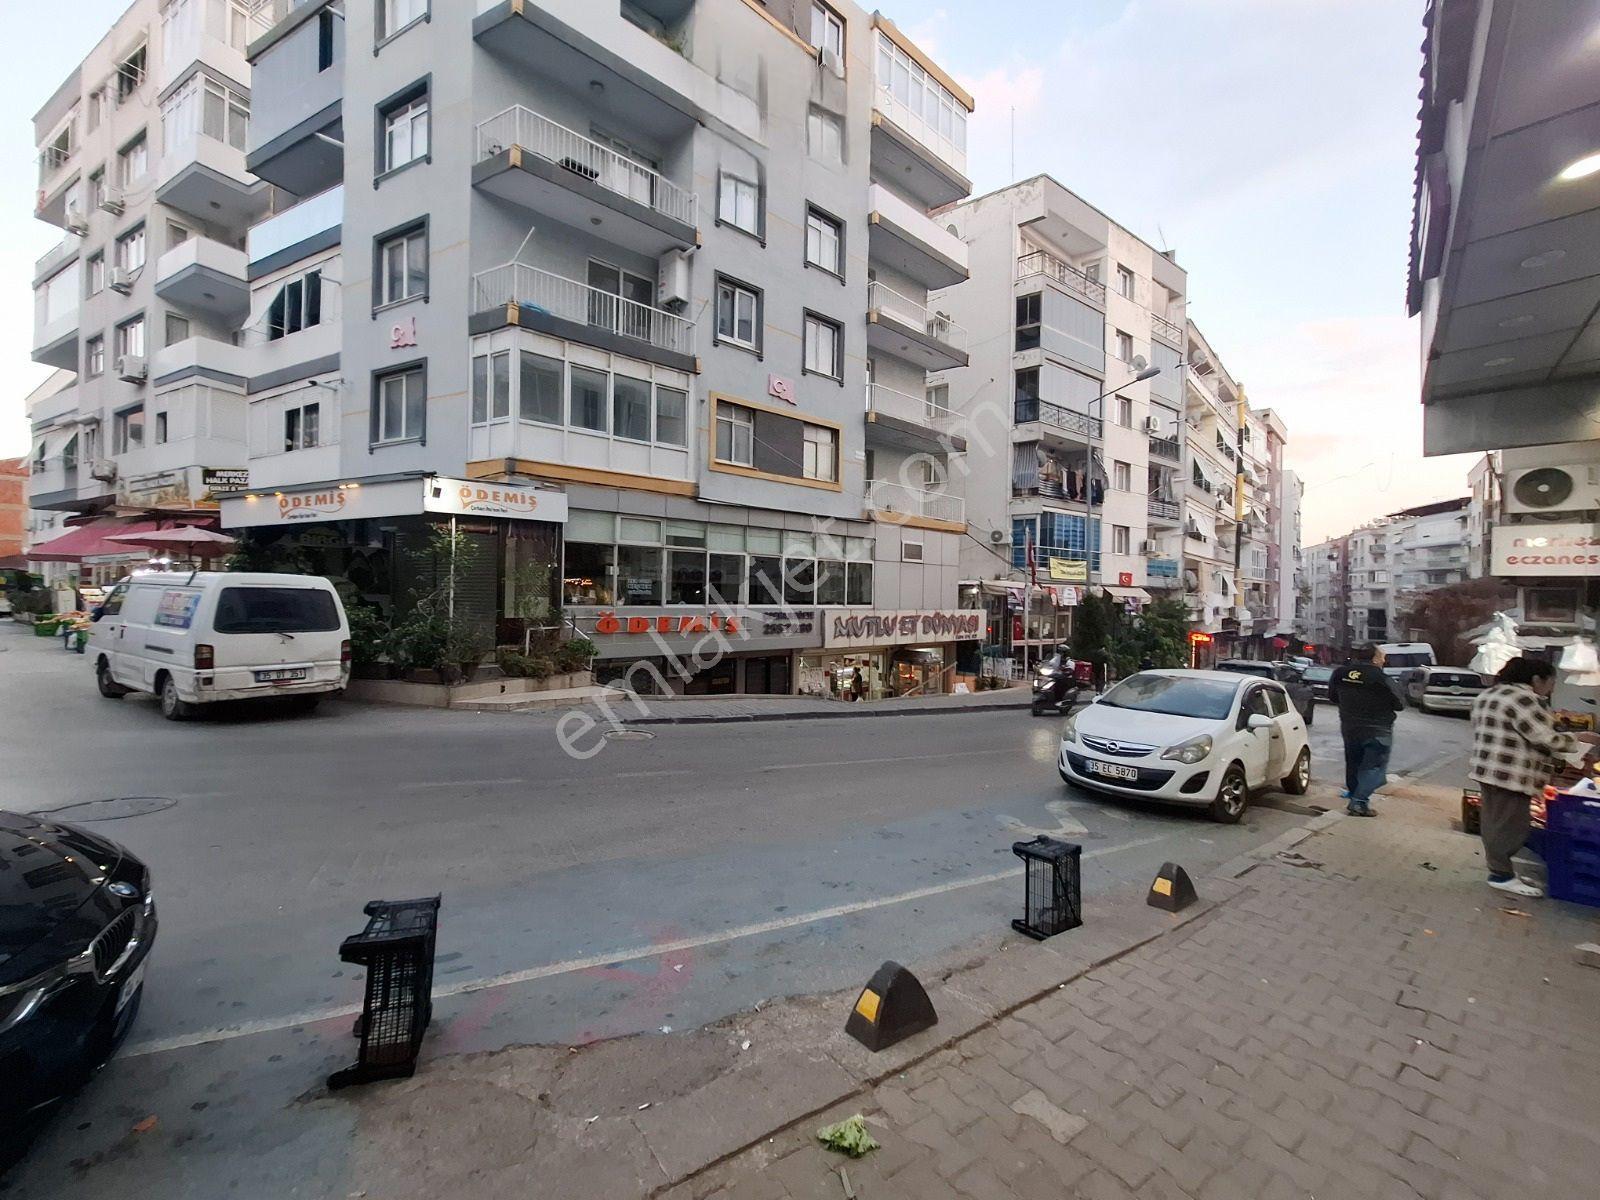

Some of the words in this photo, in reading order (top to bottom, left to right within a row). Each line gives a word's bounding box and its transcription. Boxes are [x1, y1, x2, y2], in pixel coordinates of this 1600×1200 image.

[280, 491, 345, 508] ÖDEMİŞ
[459, 484, 537, 507] ÖDEMİŞ
[1506, 555, 1600, 565] eczanes
[595, 610, 741, 634] ÖDEMİŞ
[833, 614, 898, 639] MUTLU
[898, 614, 921, 635] ET
[1090, 761, 1099, 771] 35
[1102, 764, 1112, 774] EC
[1115, 766, 1137, 778] 5870
